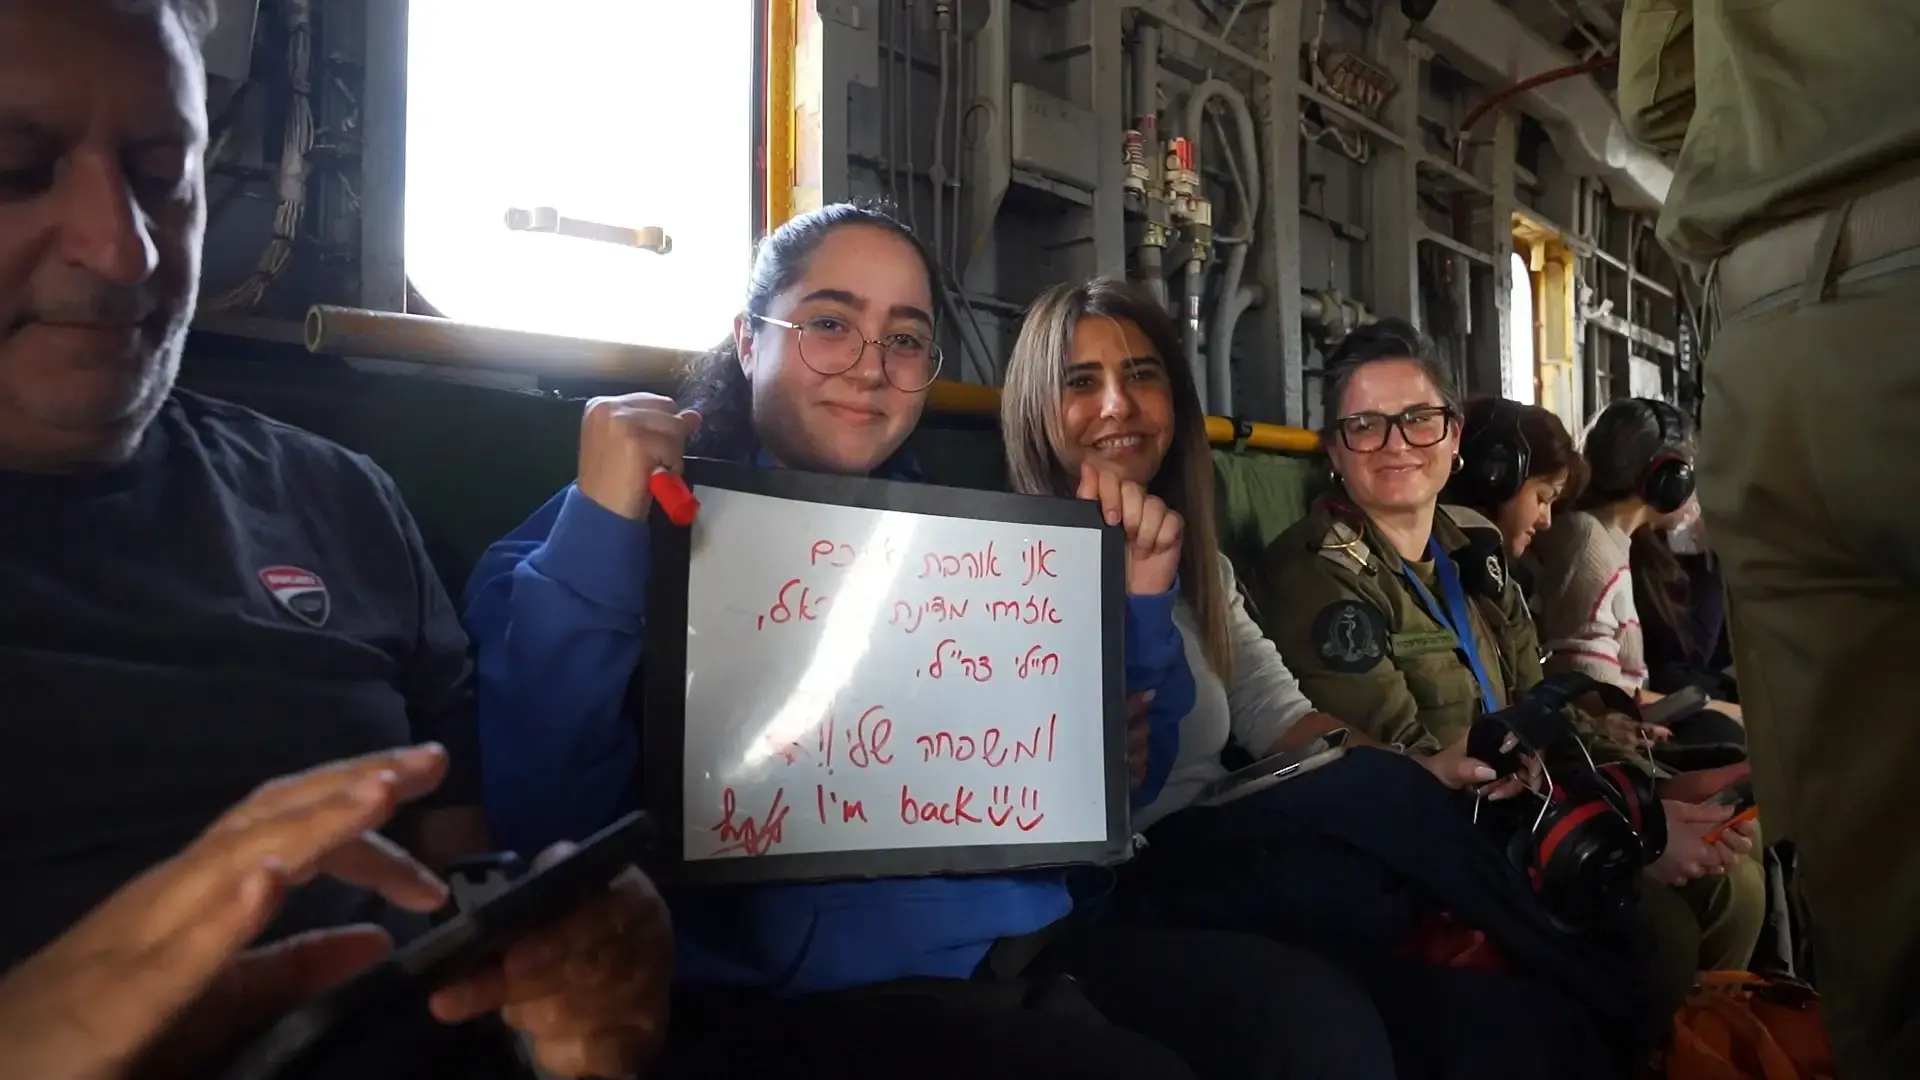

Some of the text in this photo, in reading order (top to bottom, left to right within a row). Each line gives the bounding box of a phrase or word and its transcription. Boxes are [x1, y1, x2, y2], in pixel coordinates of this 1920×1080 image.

[810, 536, 1058, 586] אני אוהבת אכם
[888, 595, 969, 633] מדינת
[985, 594, 1063, 625] אזרחי
[1014, 644, 1059, 679] חיילי
[915, 712, 1057, 768] ומשפחה
[816, 783, 868, 825] I'm
[900, 783, 983, 826] back
